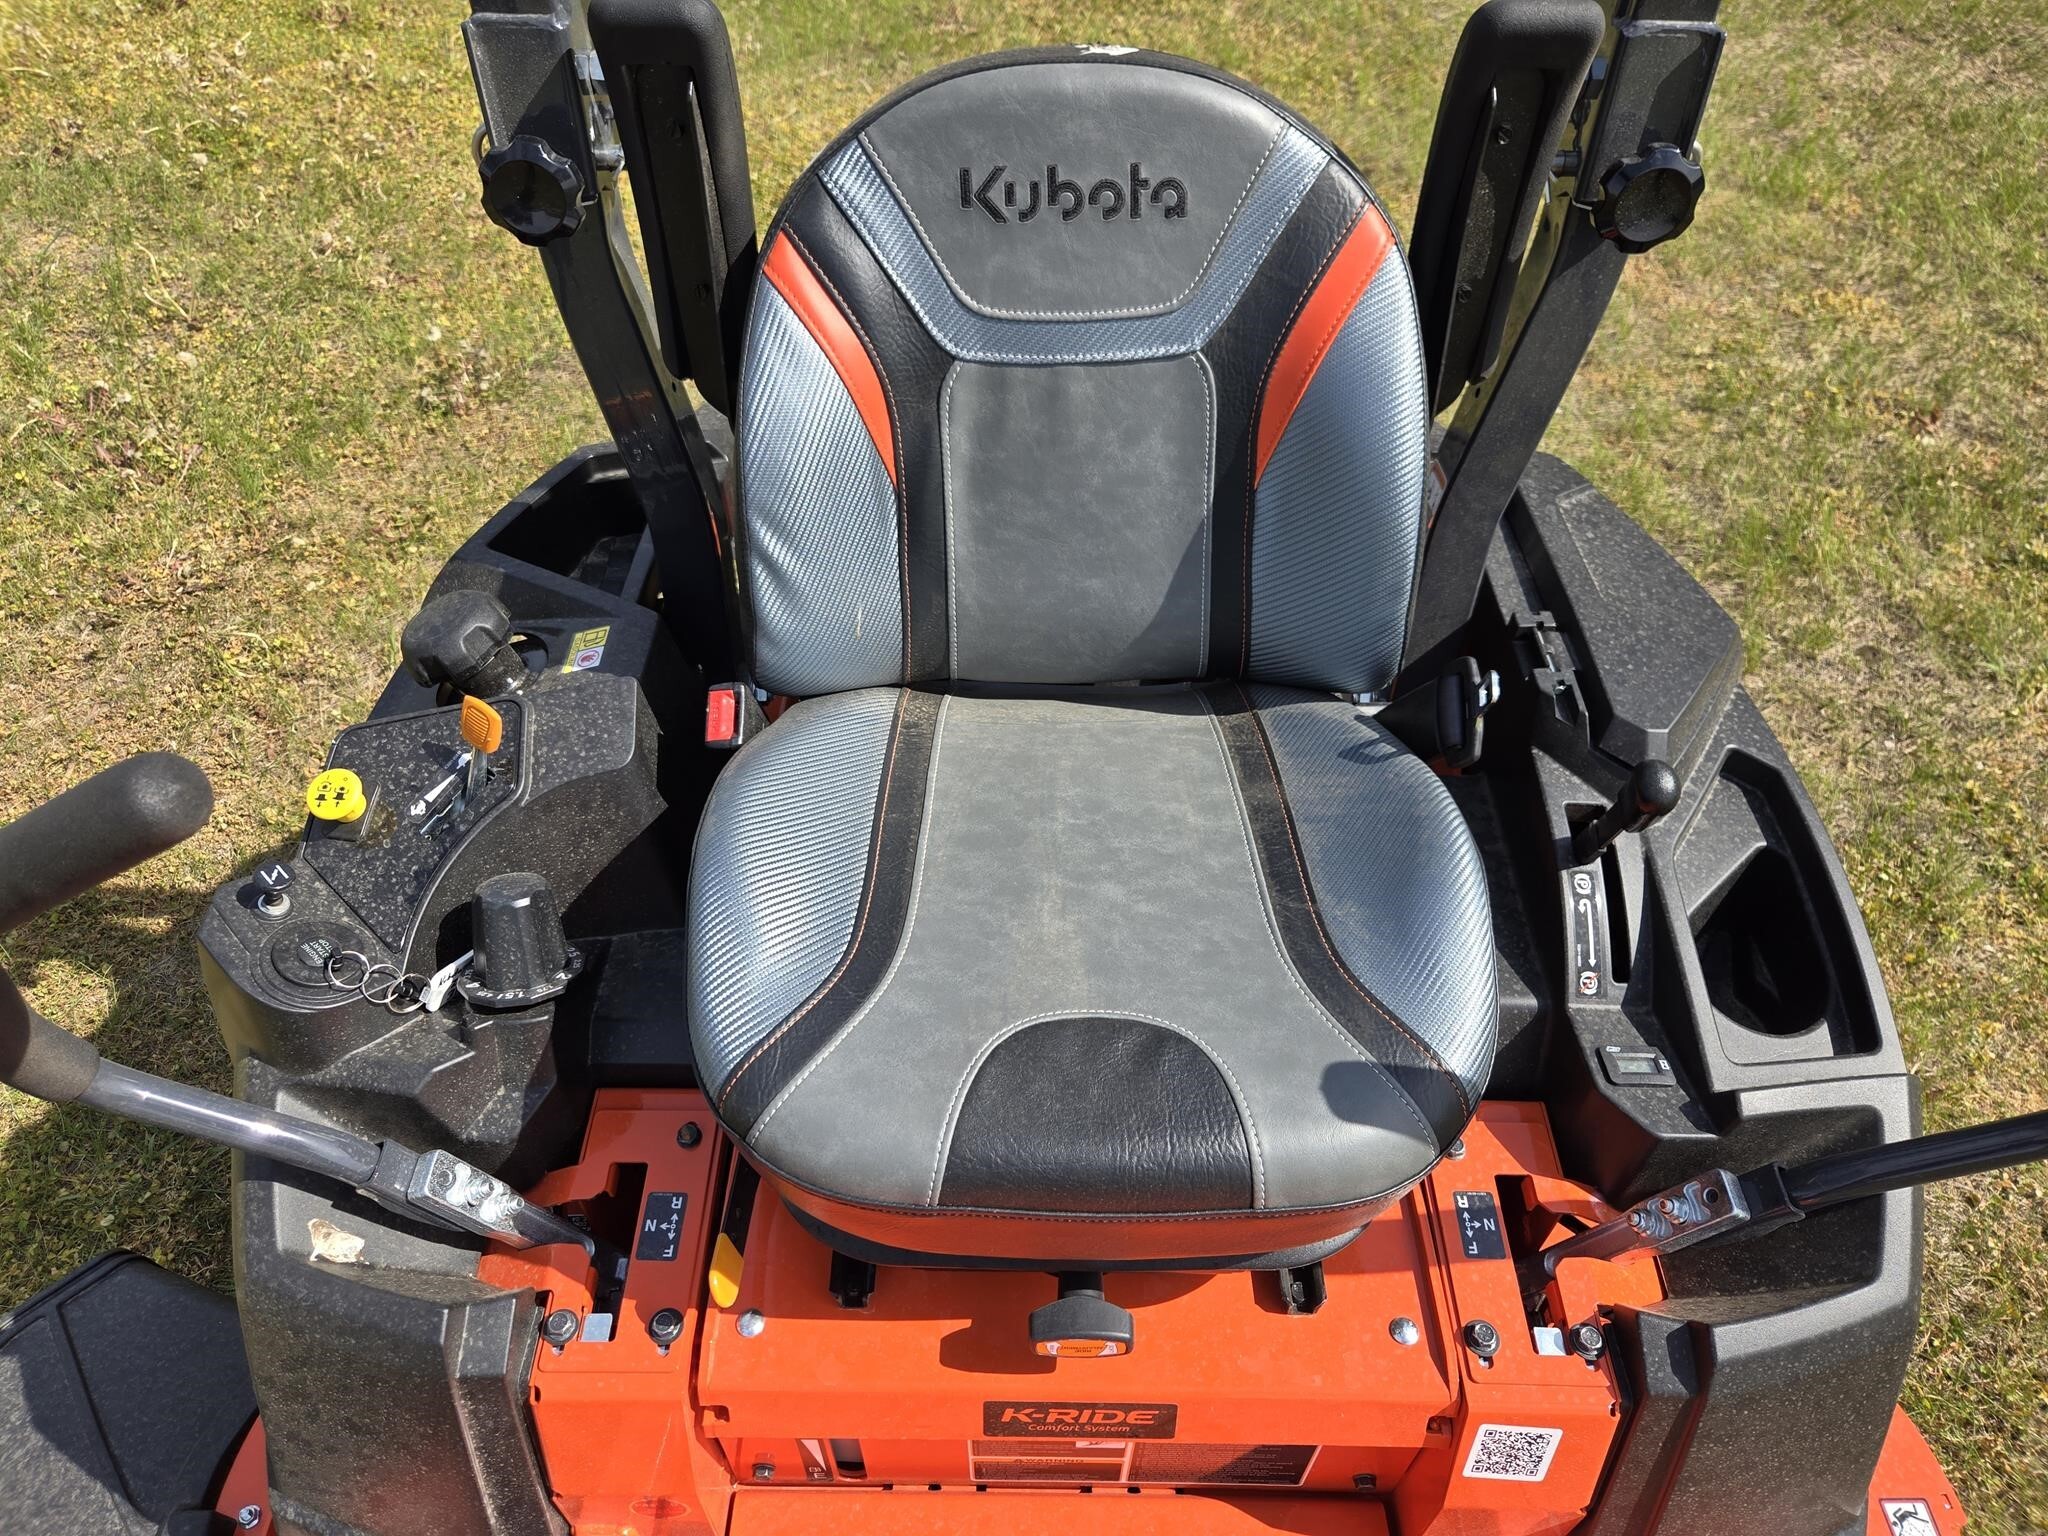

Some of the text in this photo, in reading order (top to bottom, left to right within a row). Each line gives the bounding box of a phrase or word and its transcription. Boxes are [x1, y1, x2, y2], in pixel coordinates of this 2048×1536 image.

[959, 162, 1188, 224] Kubota
[301, 943, 323, 964] ENGINE
[672, 1197, 683, 1209] R
[1456, 1195, 1469, 1208] R
[645, 1219, 657, 1232] N
[1483, 1218, 1495, 1231] N
[663, 1245, 674, 1257] F
[1469, 1242, 1478, 1254] F
[1001, 1408, 1159, 1424] K-RIDE
[1028, 1424, 1130, 1433] Comfort System
